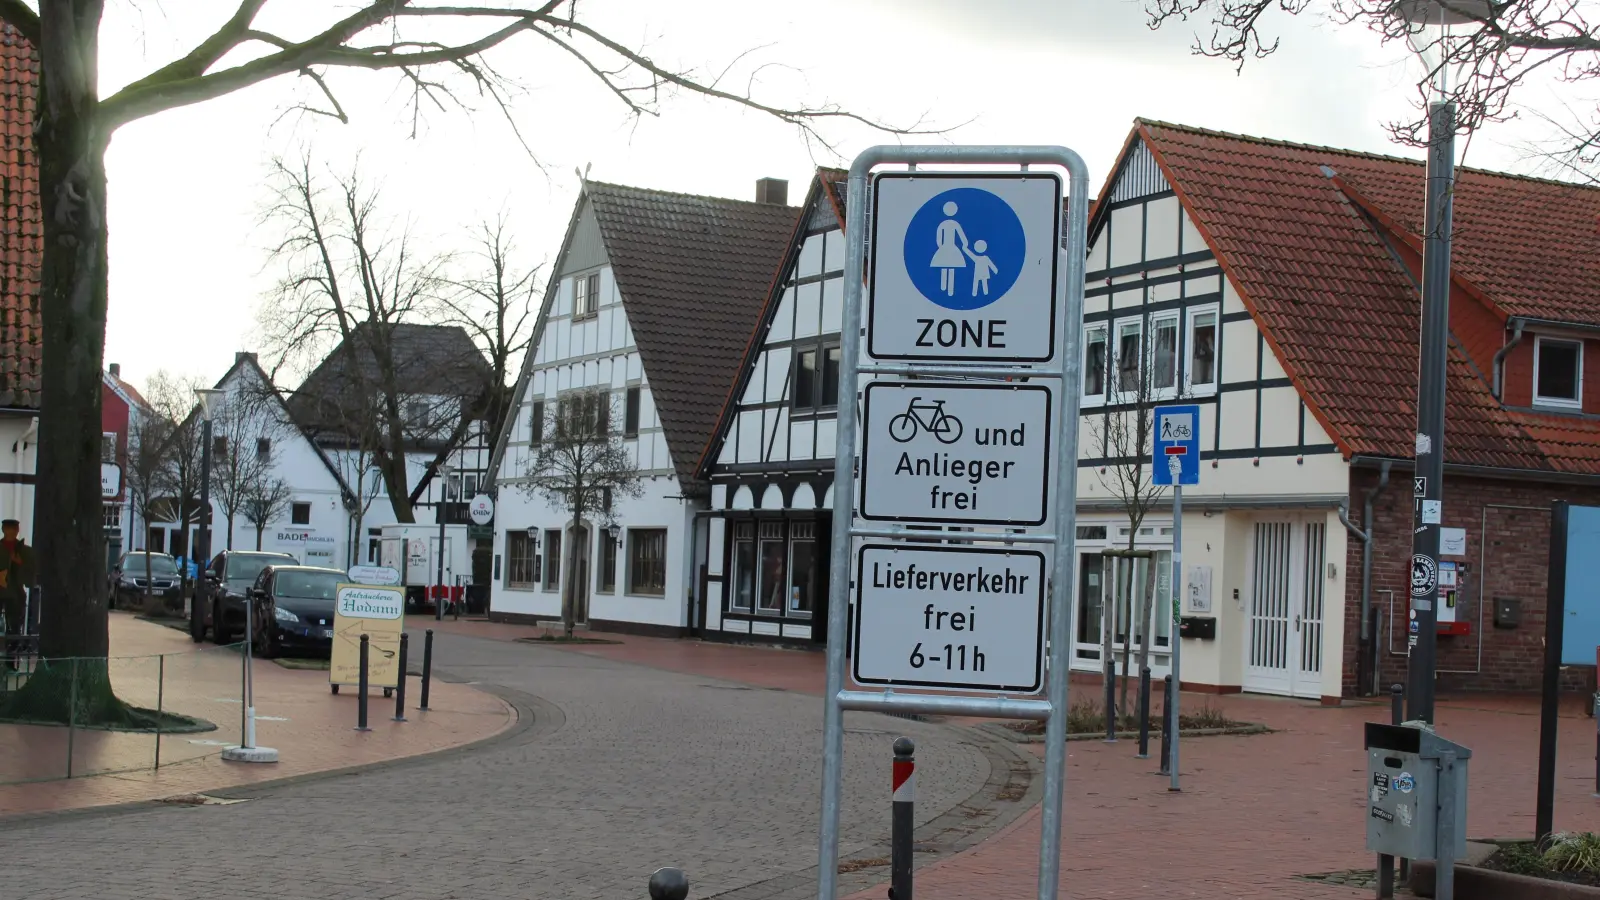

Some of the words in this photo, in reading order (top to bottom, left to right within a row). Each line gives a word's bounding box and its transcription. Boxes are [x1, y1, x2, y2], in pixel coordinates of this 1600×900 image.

[916, 319, 1006, 348] ZONE
[975, 423, 1025, 446] und
[895, 452, 1015, 484] Anlieger
[931, 486, 977, 510] frei
[472, 509, 491, 517] Gilde
[277, 532, 305, 541] BADE
[873, 562, 1029, 594] Lieferverkehr
[342, 599, 399, 615] Hodann
[924, 604, 975, 632] frei
[910, 643, 985, 671] 6-11h
